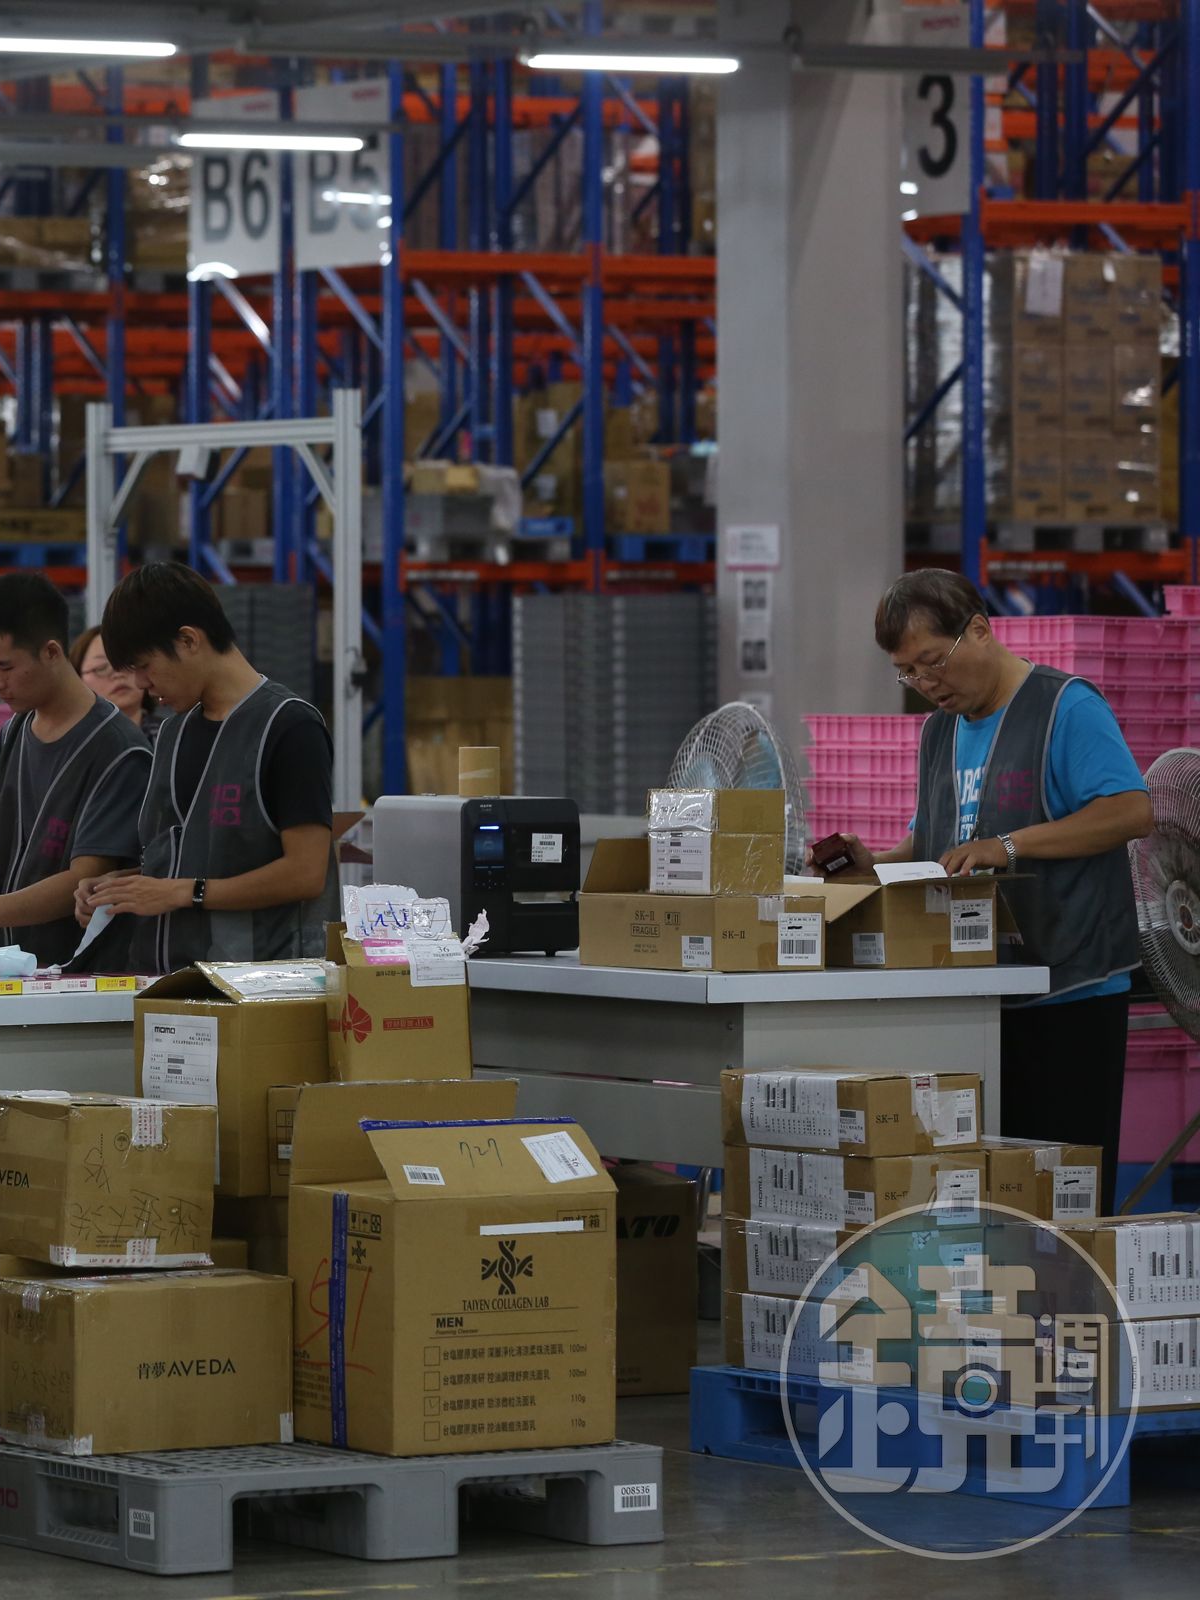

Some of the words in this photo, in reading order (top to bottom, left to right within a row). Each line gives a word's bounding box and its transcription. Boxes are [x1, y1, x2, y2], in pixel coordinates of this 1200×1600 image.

[917, 74, 958, 179] 3
[202, 150, 270, 242] B6
[632, 924, 659, 936] FRAGILE
[154, 1026, 176, 1034] momo
[616, 1214, 680, 1239] ATO
[462, 1299, 490, 1312] TAIYEN
[491, 1297, 533, 1311] COLLAGEN
[535, 1296, 549, 1308] LAB
[436, 1316, 464, 1329] MEN
[167, 1358, 237, 1378] AVEDA
[621, 1485, 650, 1496] 008536
